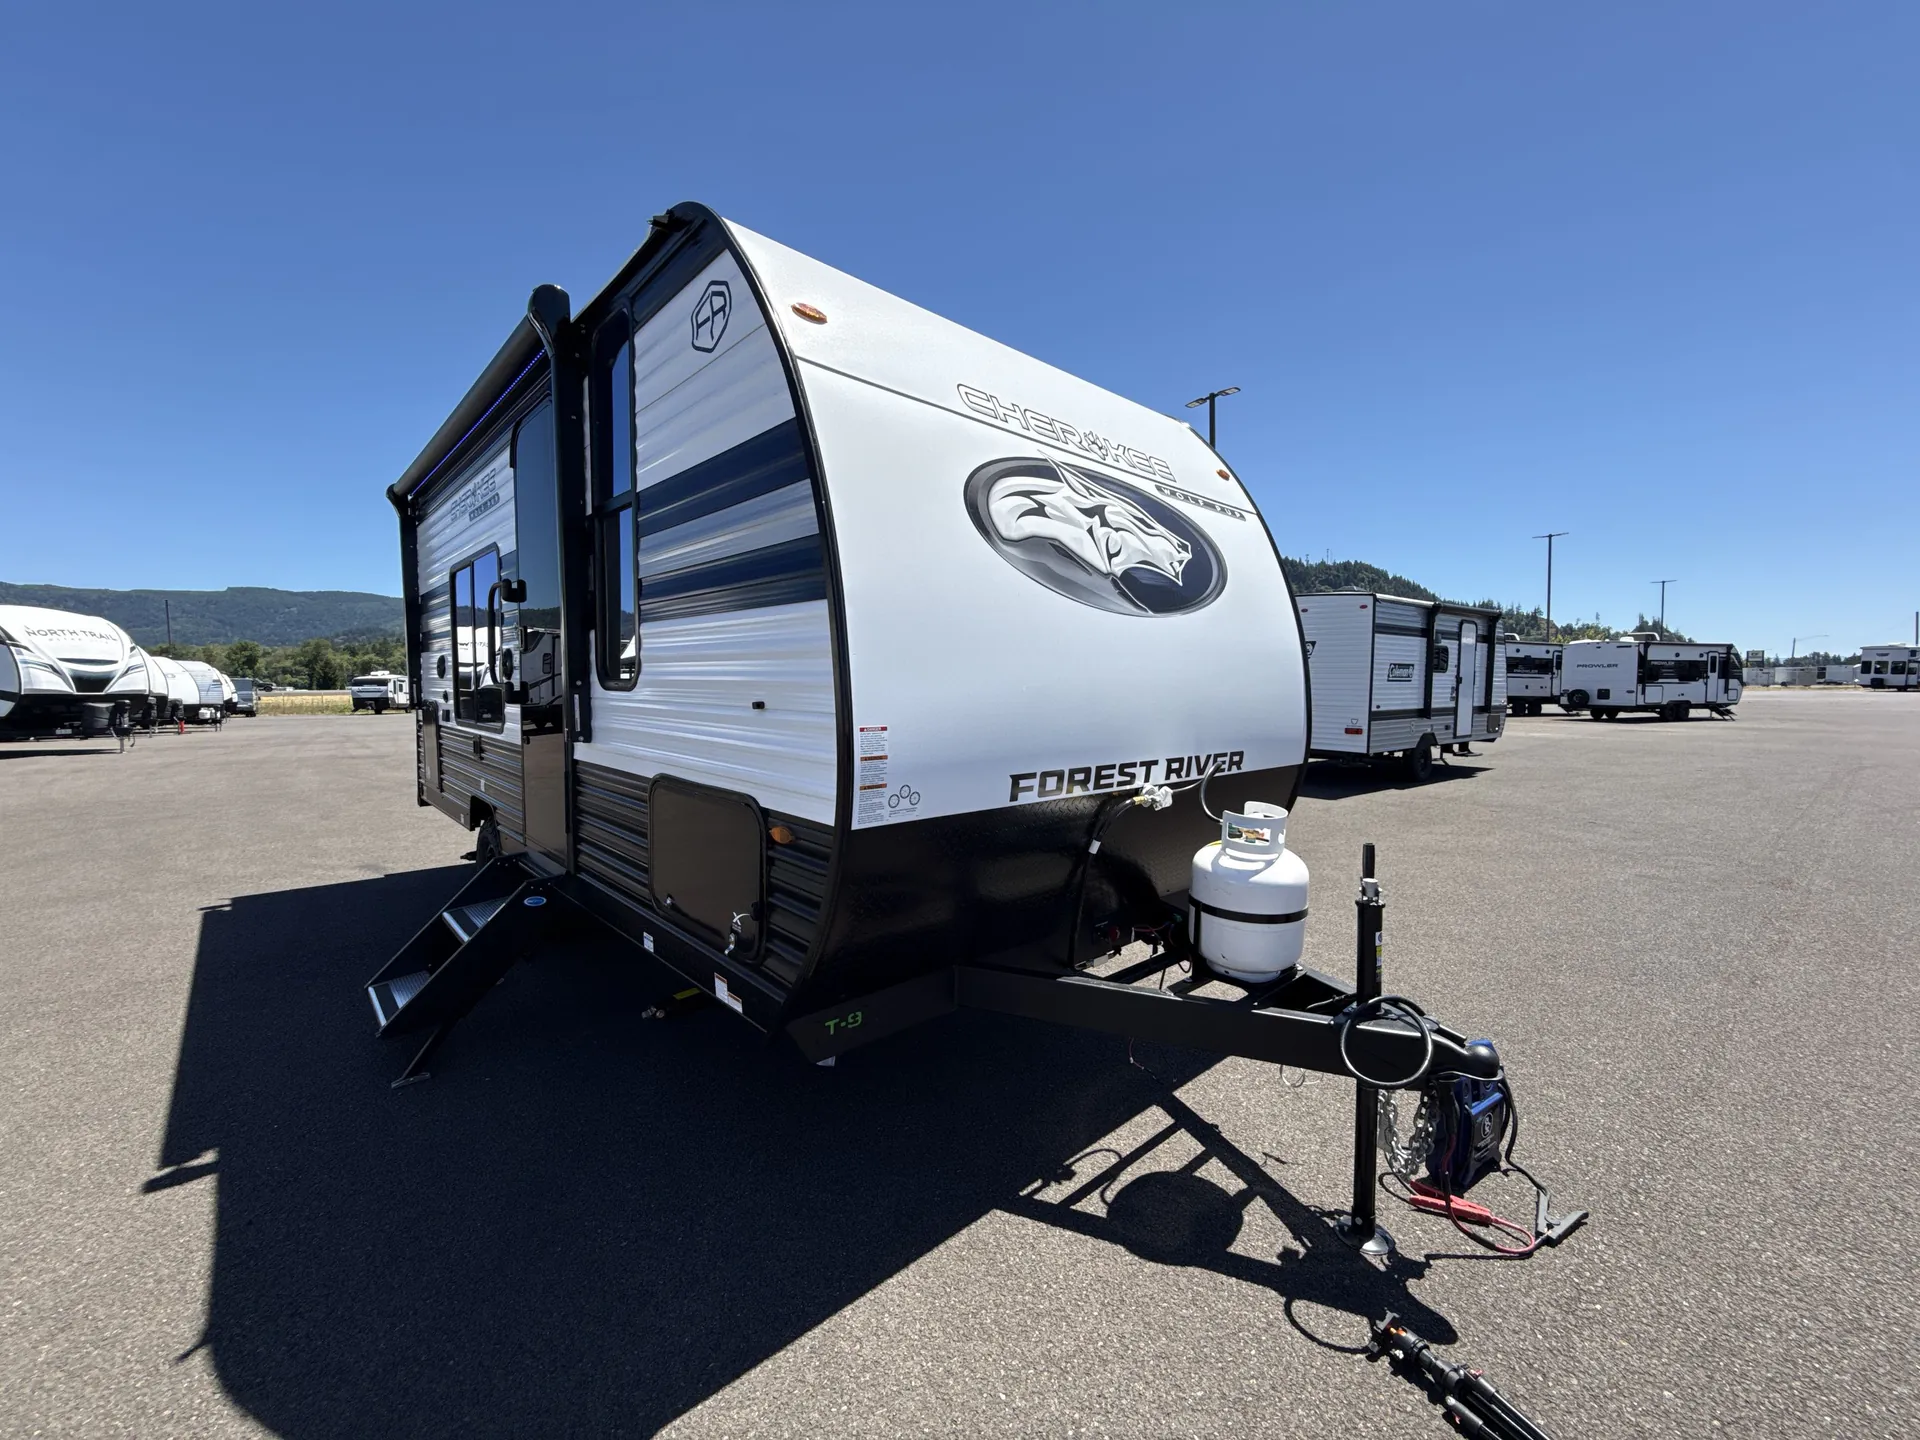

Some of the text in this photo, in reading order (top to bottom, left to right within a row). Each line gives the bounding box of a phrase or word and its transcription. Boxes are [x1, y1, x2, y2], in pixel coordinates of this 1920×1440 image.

[957, 384, 1177, 483] CHEROKEE
[1160, 486, 1241, 519] WOLF PUP
[24, 627, 79, 637] NORTH
[80, 630, 119, 642] TRAIL
[1009, 750, 1244, 802] FOREST RIVER
